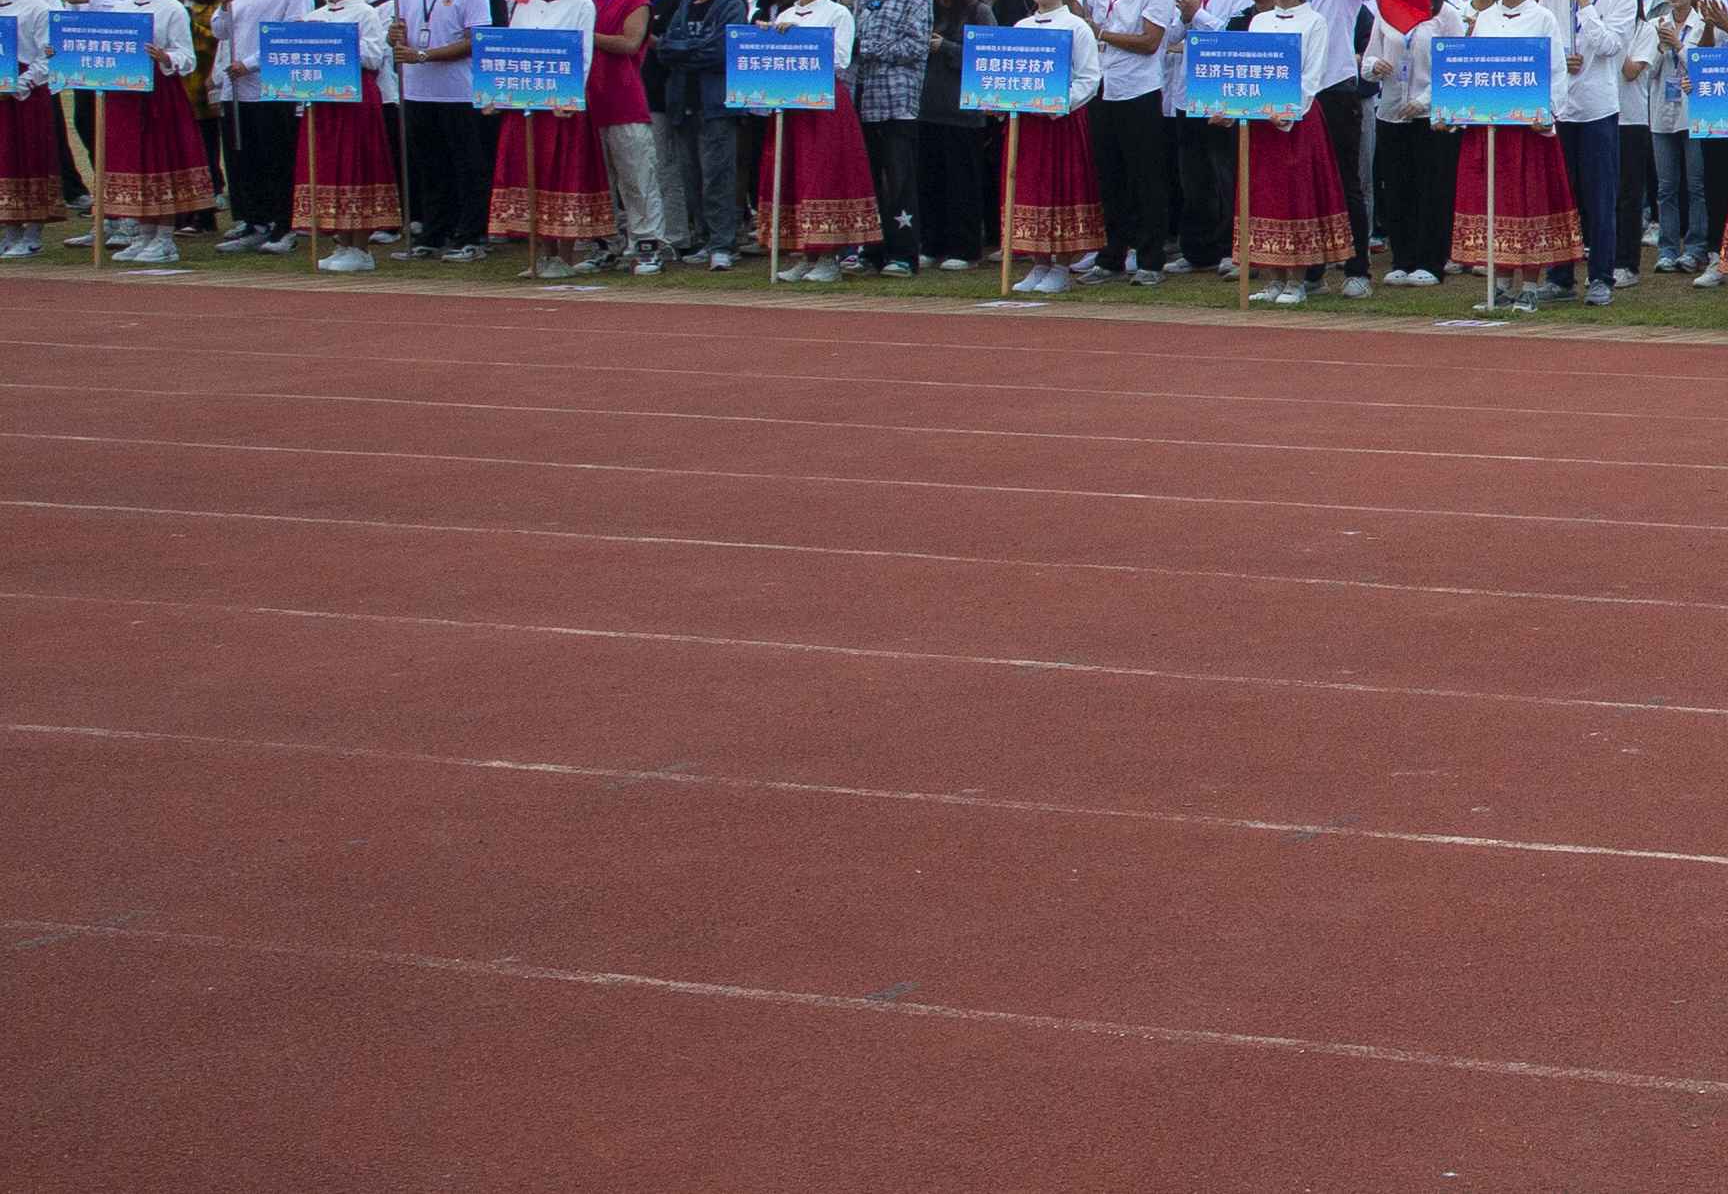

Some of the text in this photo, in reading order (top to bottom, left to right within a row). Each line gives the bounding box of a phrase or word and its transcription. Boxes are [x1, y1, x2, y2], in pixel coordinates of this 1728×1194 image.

[480, 58, 572, 75] 物理与电子工程
[736, 55, 822, 72] 音乐学院代表队
[975, 57, 1056, 74] 信息科学技术
[1194, 63, 1289, 80] 经济与管理学院
[495, 76, 557, 91] 学院代表队
[981, 76, 1046, 92] 学院代表队
[1442, 71, 1539, 88] 文学院代表队
[1221, 82, 1262, 98] 代表队
